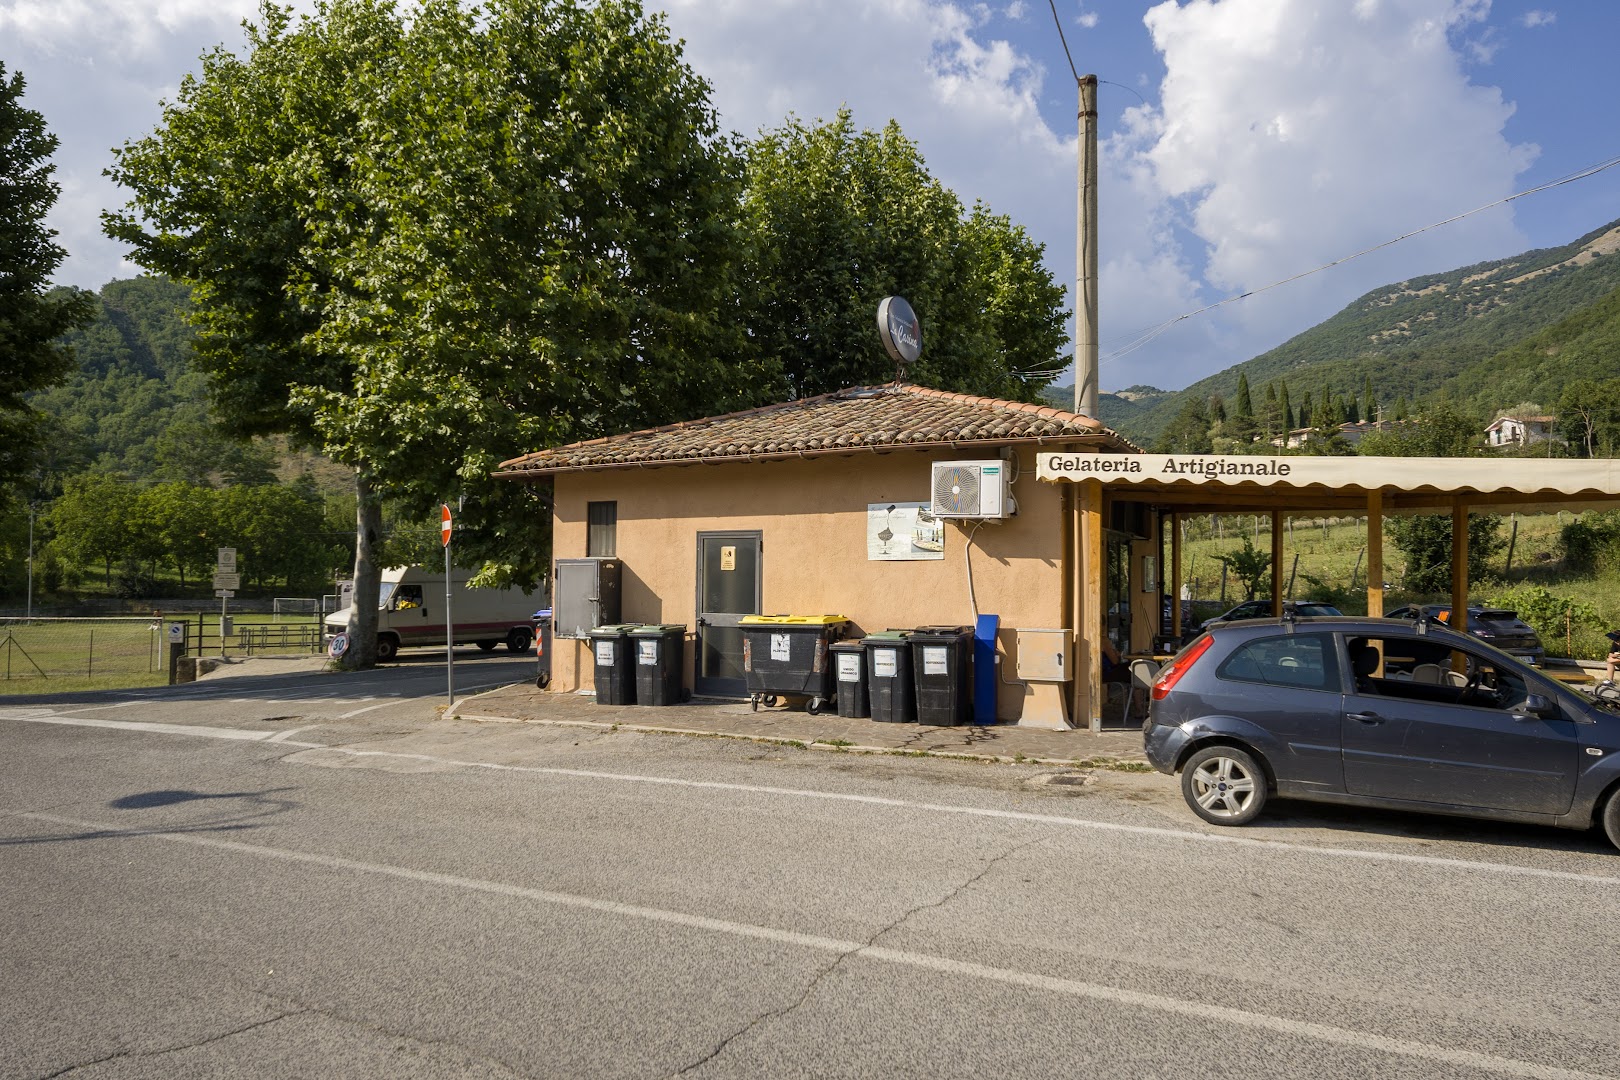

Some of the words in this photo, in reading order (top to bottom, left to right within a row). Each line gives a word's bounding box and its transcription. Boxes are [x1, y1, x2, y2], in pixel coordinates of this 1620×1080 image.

[1048, 455, 1142, 473] Gelateria
[1161, 458, 1291, 479] Artigianale
[333, 639, 345, 651] 30
